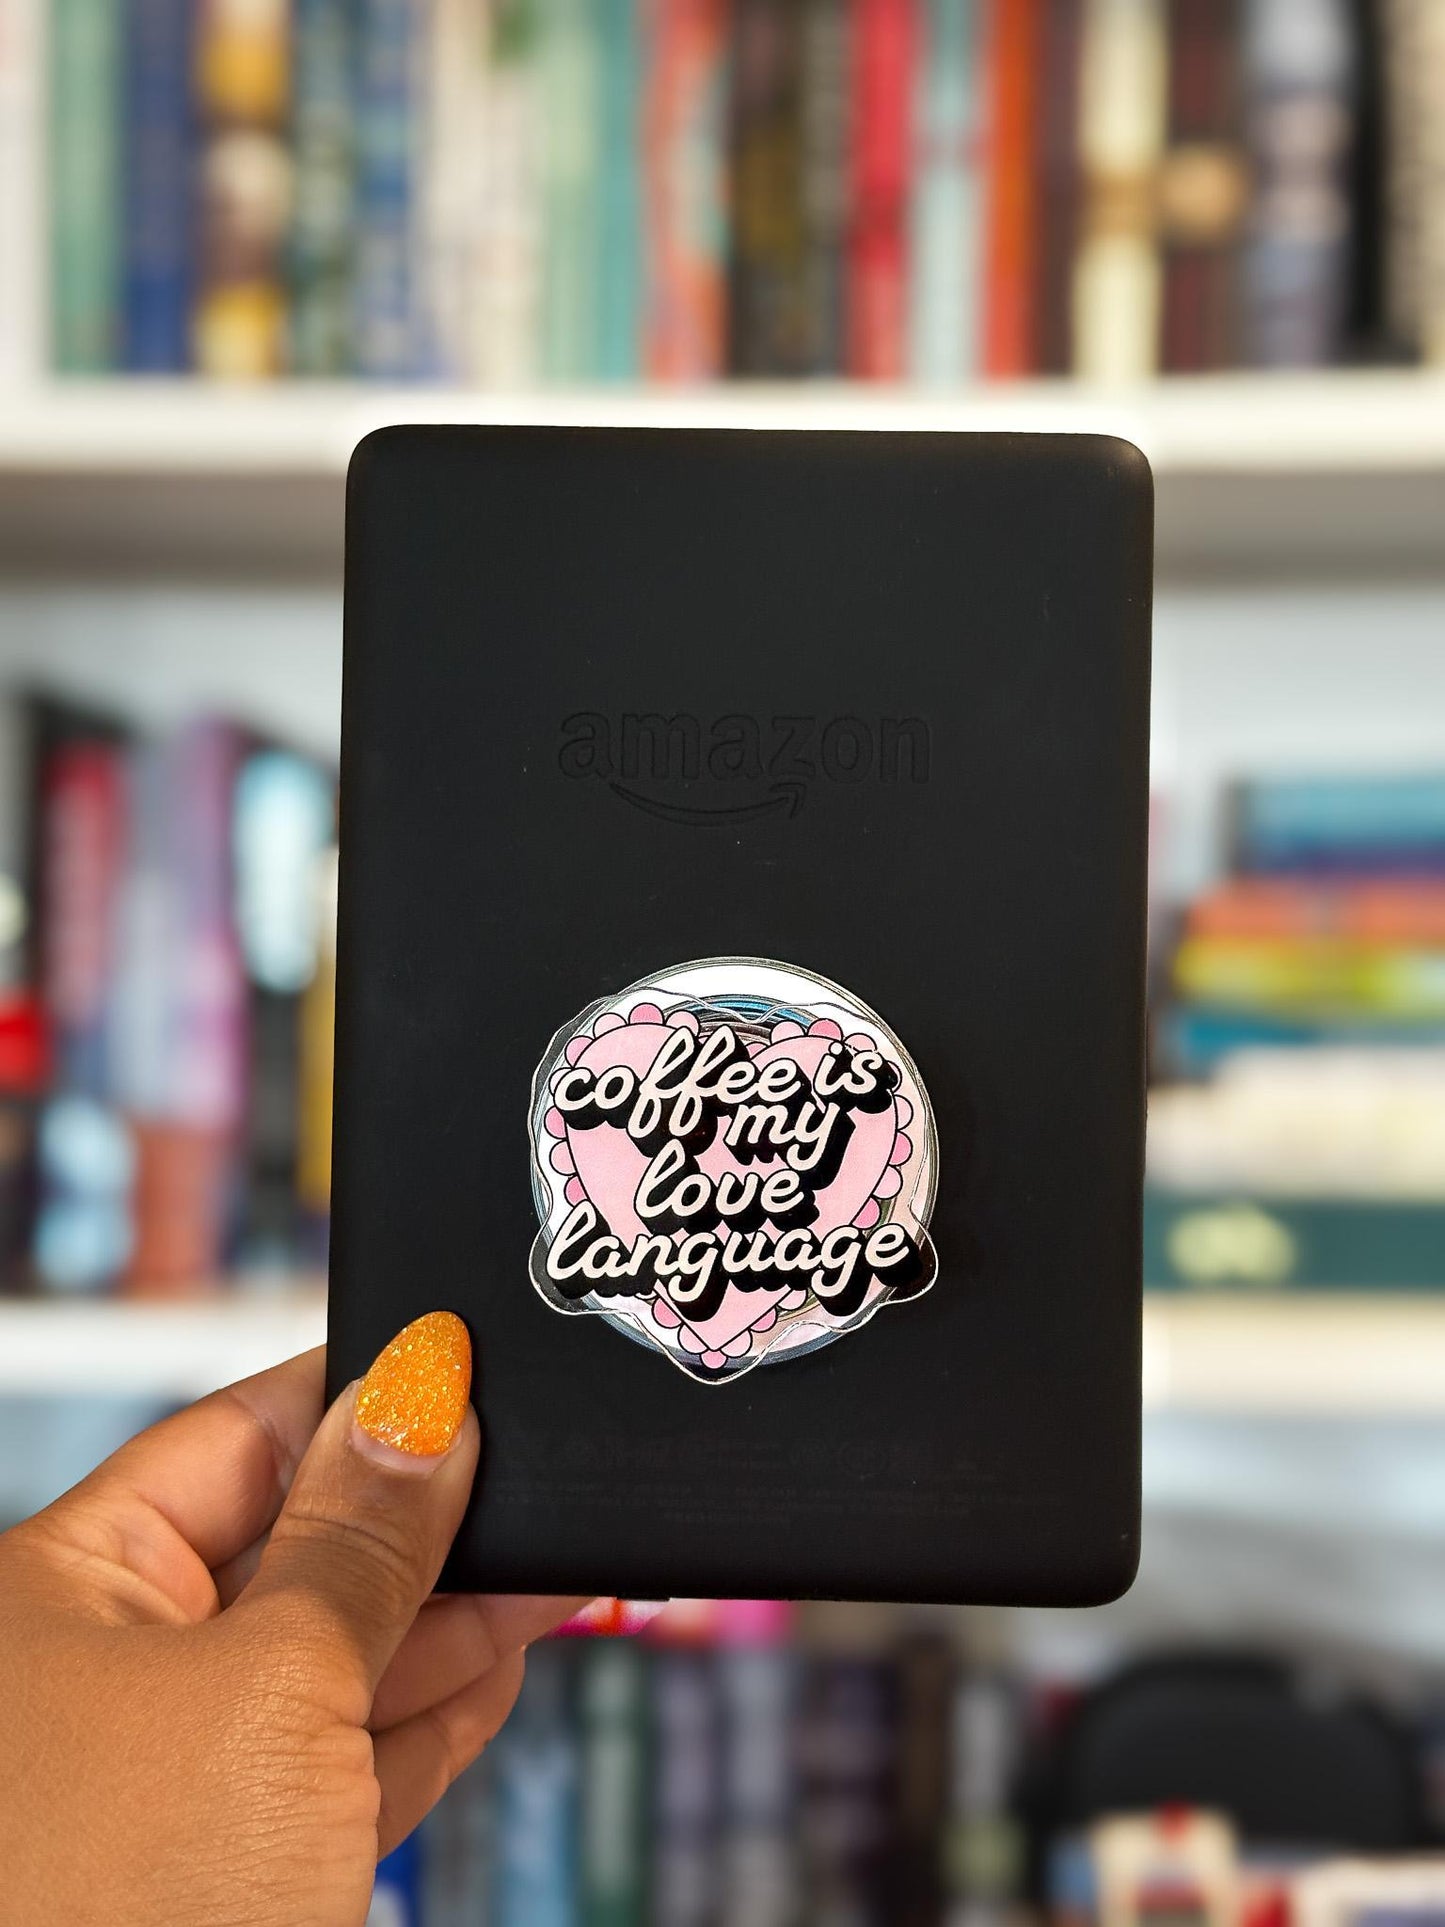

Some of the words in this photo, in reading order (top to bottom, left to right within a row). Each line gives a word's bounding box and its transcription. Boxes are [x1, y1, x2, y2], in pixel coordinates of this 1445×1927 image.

[558, 711, 931, 784] amazon
[554, 1026, 802, 1140] coffee
[811, 1040, 885, 1097] is
[723, 1100, 842, 1171] my
[634, 1138, 806, 1219] love
[546, 1199, 911, 1303] language
